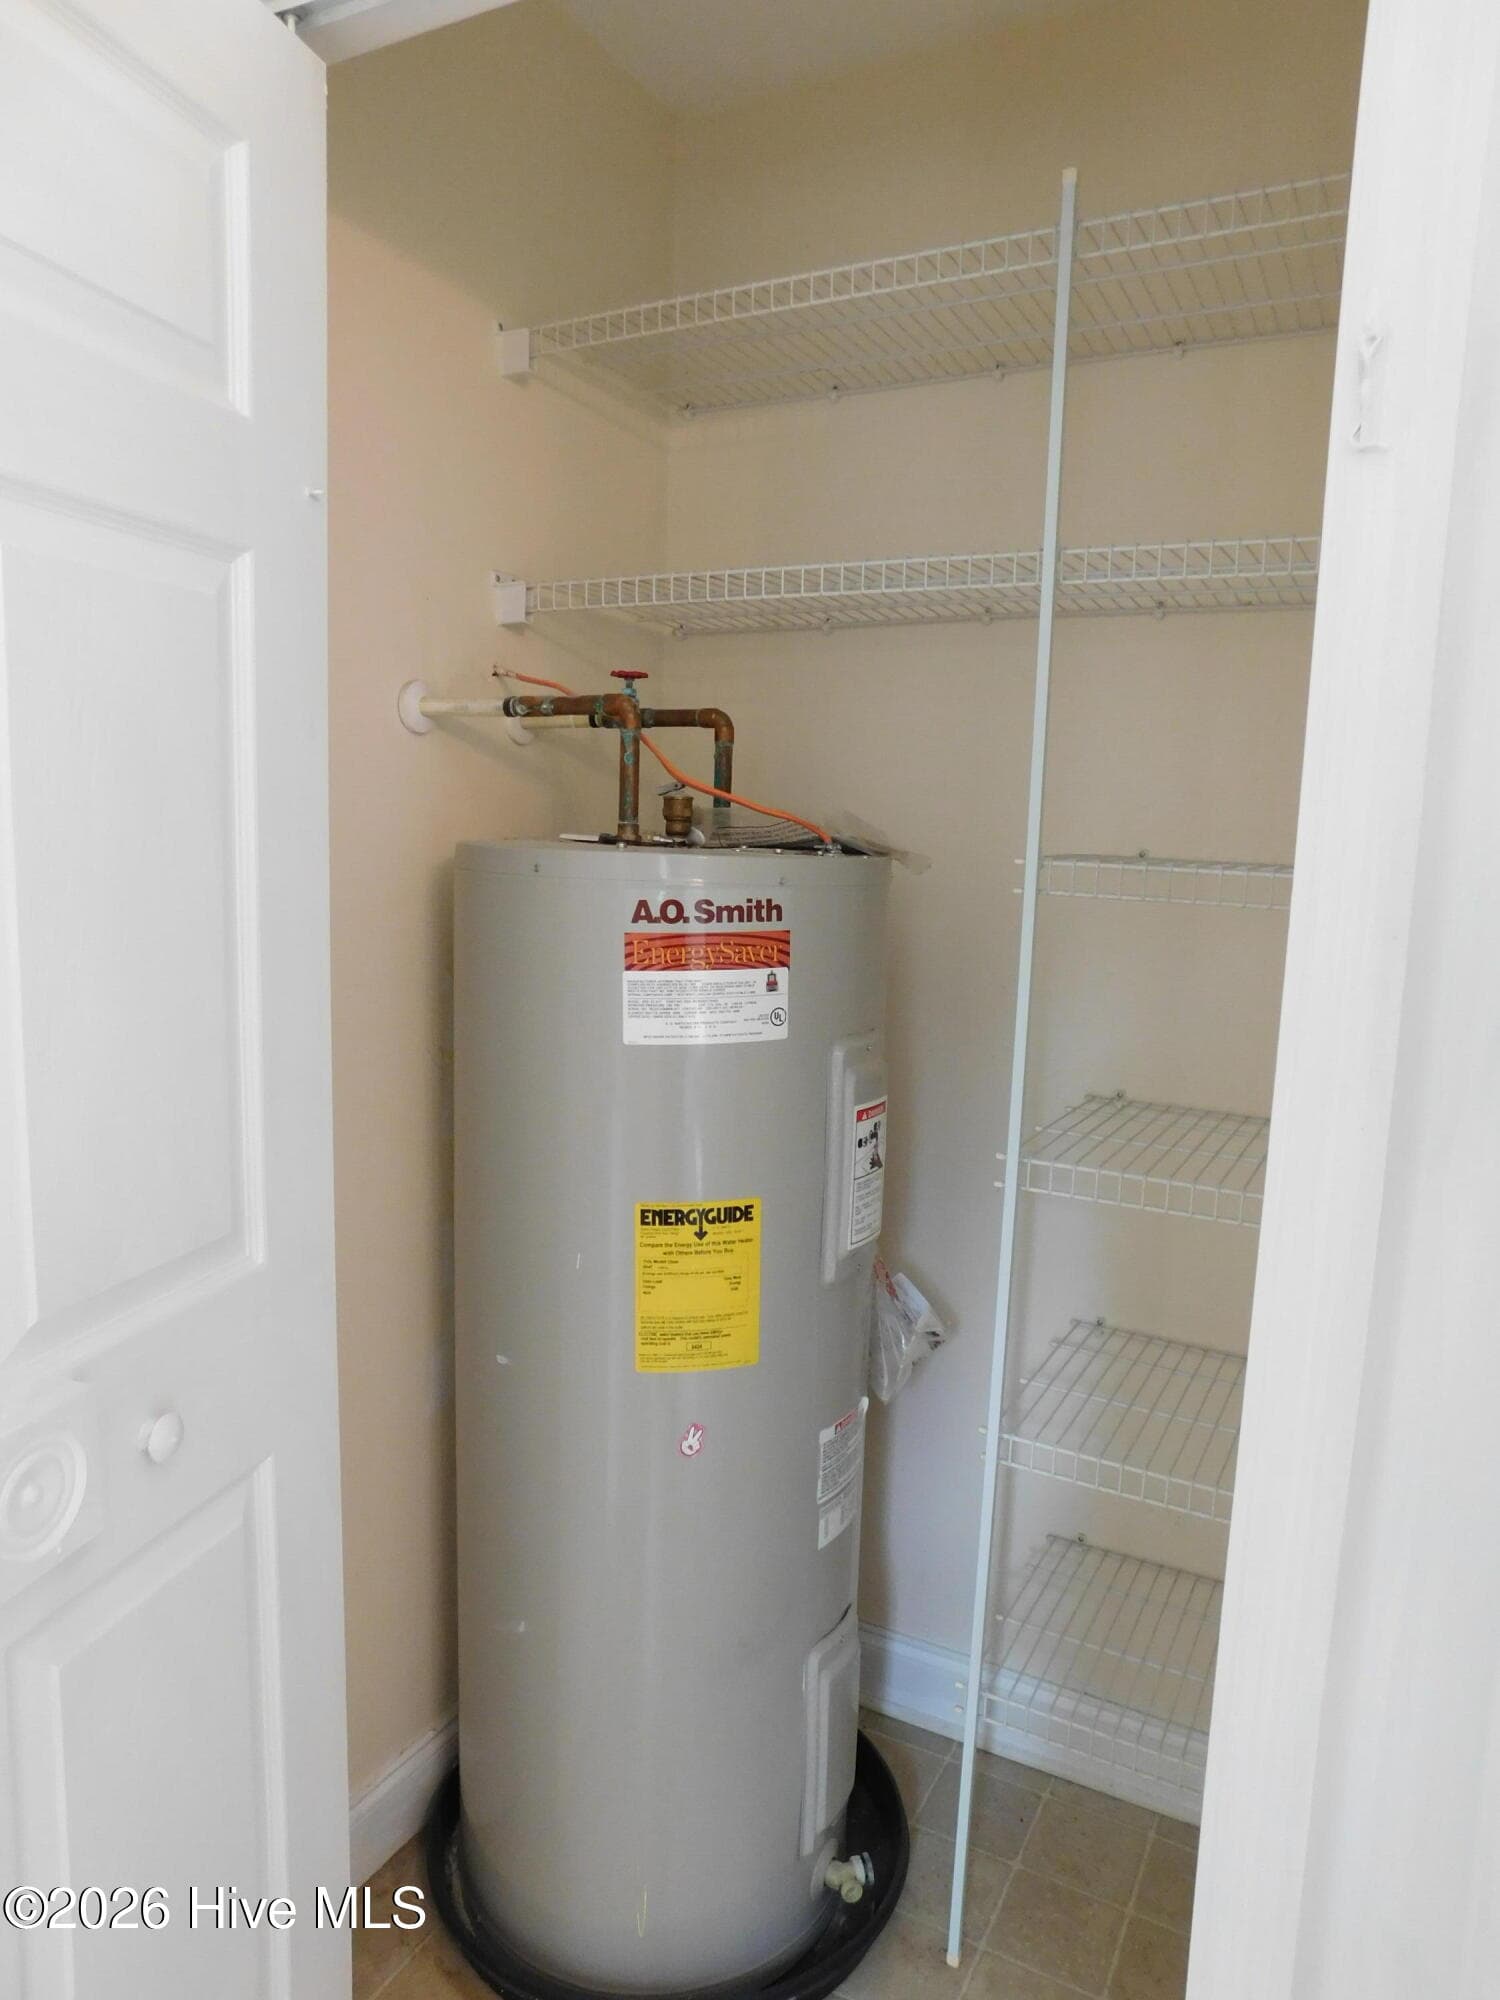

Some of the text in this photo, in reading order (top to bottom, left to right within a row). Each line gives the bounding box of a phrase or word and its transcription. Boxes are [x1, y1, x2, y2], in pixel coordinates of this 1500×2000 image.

[631, 898, 783, 924] A.O. Smith
[632, 940, 781, 969] EnergySaver
[640, 1204, 754, 1226] ENERGYGUIDE
